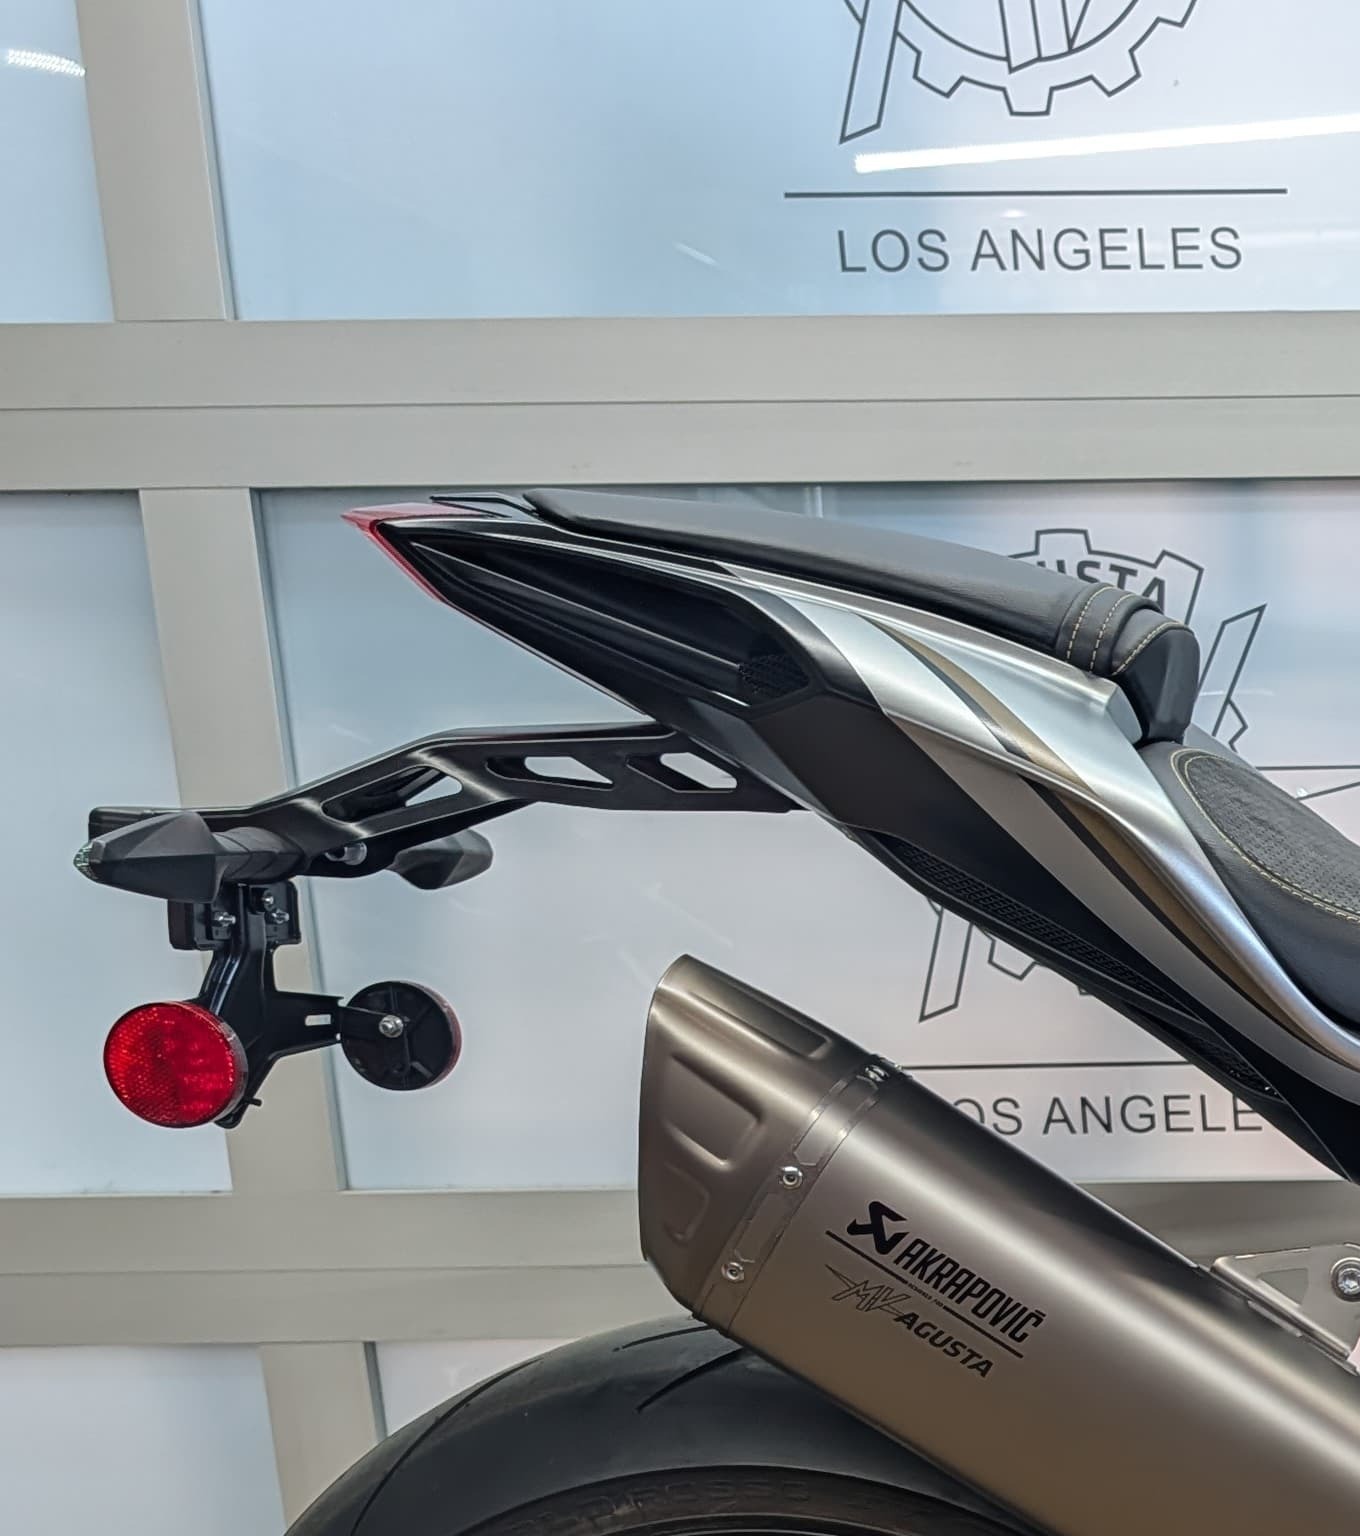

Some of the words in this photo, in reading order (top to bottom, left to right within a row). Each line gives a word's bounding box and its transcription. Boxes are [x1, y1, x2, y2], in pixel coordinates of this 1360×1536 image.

[836, 228, 950, 273] LOS
[971, 225, 1243, 272] ANGELES
[1042, 1093, 1263, 1135] ANGELE
[893, 1310, 994, 1378] AGUSTA
